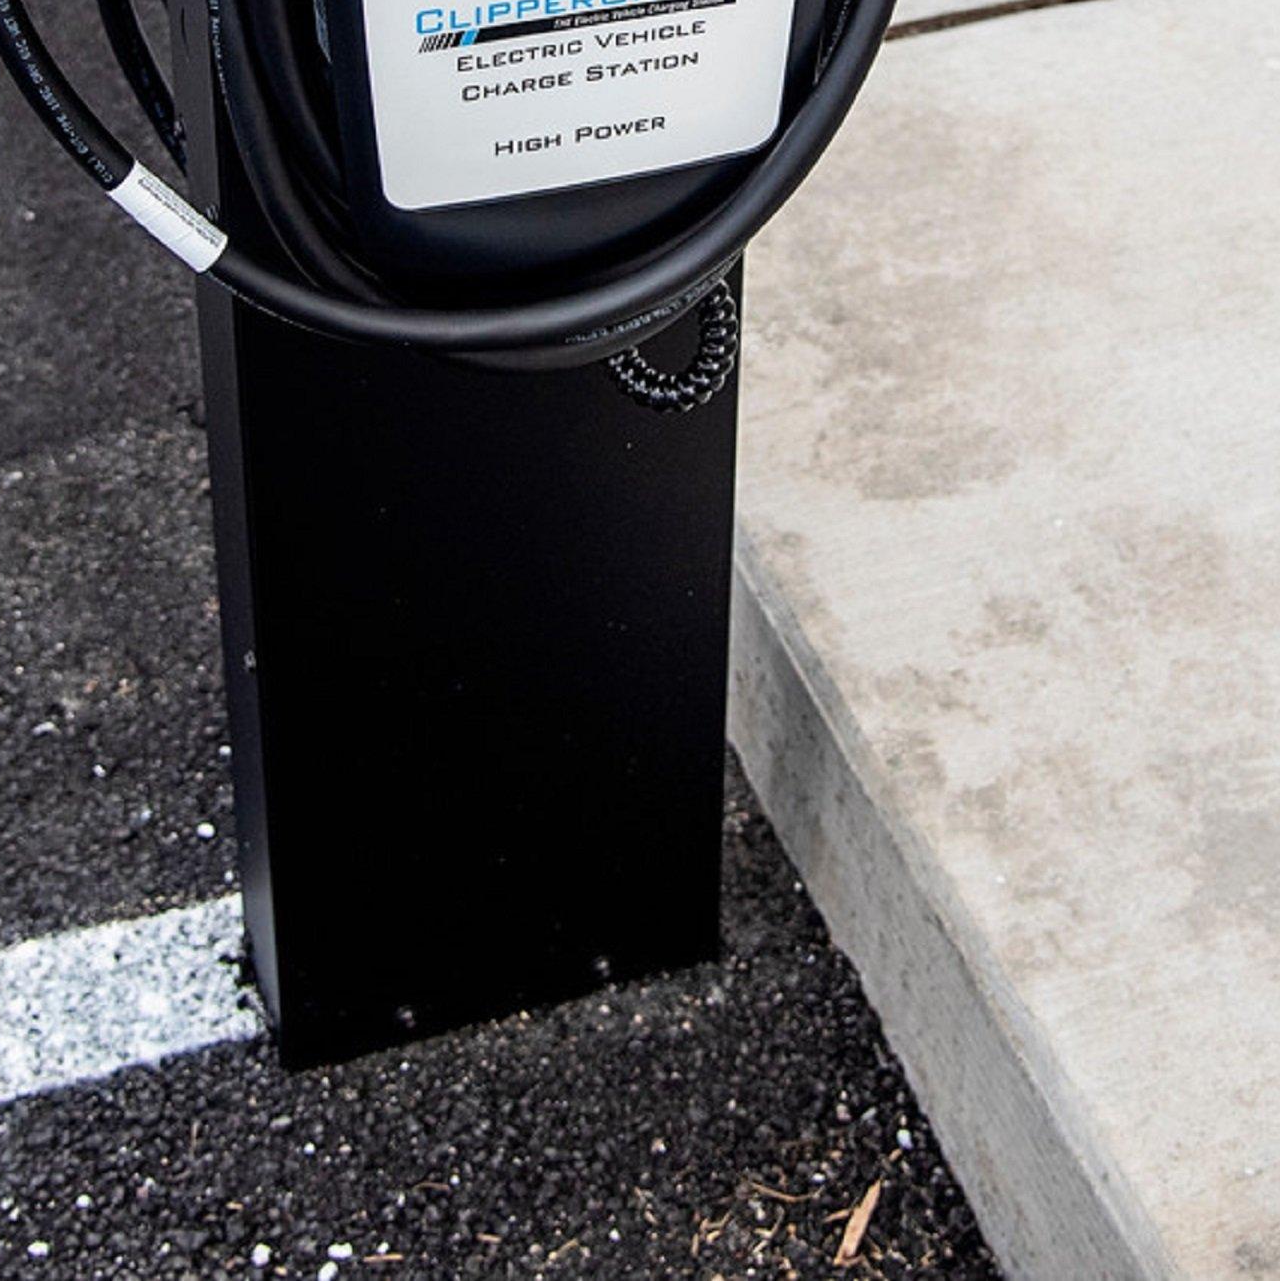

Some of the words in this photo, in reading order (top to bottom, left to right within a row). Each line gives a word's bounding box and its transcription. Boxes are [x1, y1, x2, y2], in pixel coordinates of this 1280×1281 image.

[457, 39, 583, 72] ELECTRIC
[594, 20, 706, 49] VEHICLE
[461, 71, 573, 102] CHARGE
[586, 51, 700, 82] STATION
[494, 133, 562, 157] HIGH
[575, 116, 665, 143] POWER
